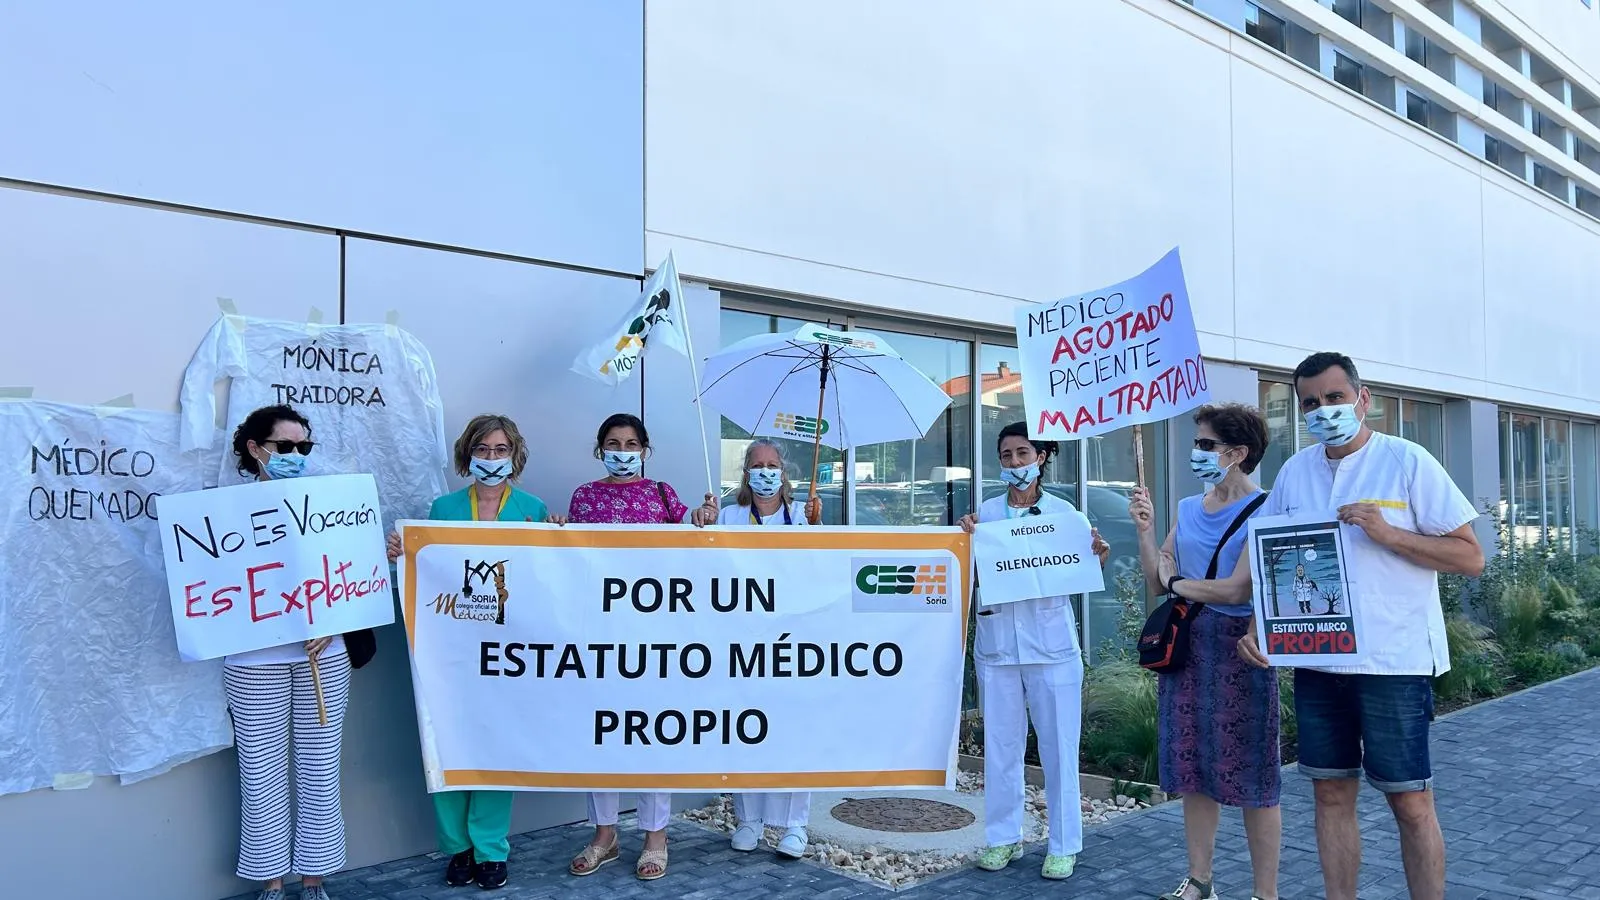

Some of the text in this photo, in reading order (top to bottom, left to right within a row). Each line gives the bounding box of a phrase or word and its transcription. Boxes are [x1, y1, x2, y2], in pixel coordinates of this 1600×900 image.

[1028, 292, 1125, 338] MÉDICO
[1051, 292, 1175, 365] AGOTADO
[283, 340, 383, 375] MÓNICA
[1049, 337, 1161, 398] PACIENTE
[271, 384, 386, 408] TRAIDORA
[1037, 353, 1208, 435] MALTRATADO
[31, 438, 155, 478] MÉDICO
[29, 486, 162, 523] QUEMADO
[173, 494, 377, 563] No Es Vocación
[1010, 524, 1055, 537] MÉDICOS
[856, 565, 946, 594] CESM
[995, 553, 1081, 573] SILENCIADOS
[185, 554, 389, 625] Es Explotación
[426, 593, 496, 621] Médicos
[471, 595, 497, 603] SORIA
[602, 577, 776, 613] POR UN
[926, 596, 947, 605] Soria
[1268, 631, 1356, 654] PROPIO
[1272, 621, 1348, 634] ESTATUTO MARCO
[480, 632, 904, 679] ESTATUTO MÉDICO
[594, 708, 769, 746] PROPIO
